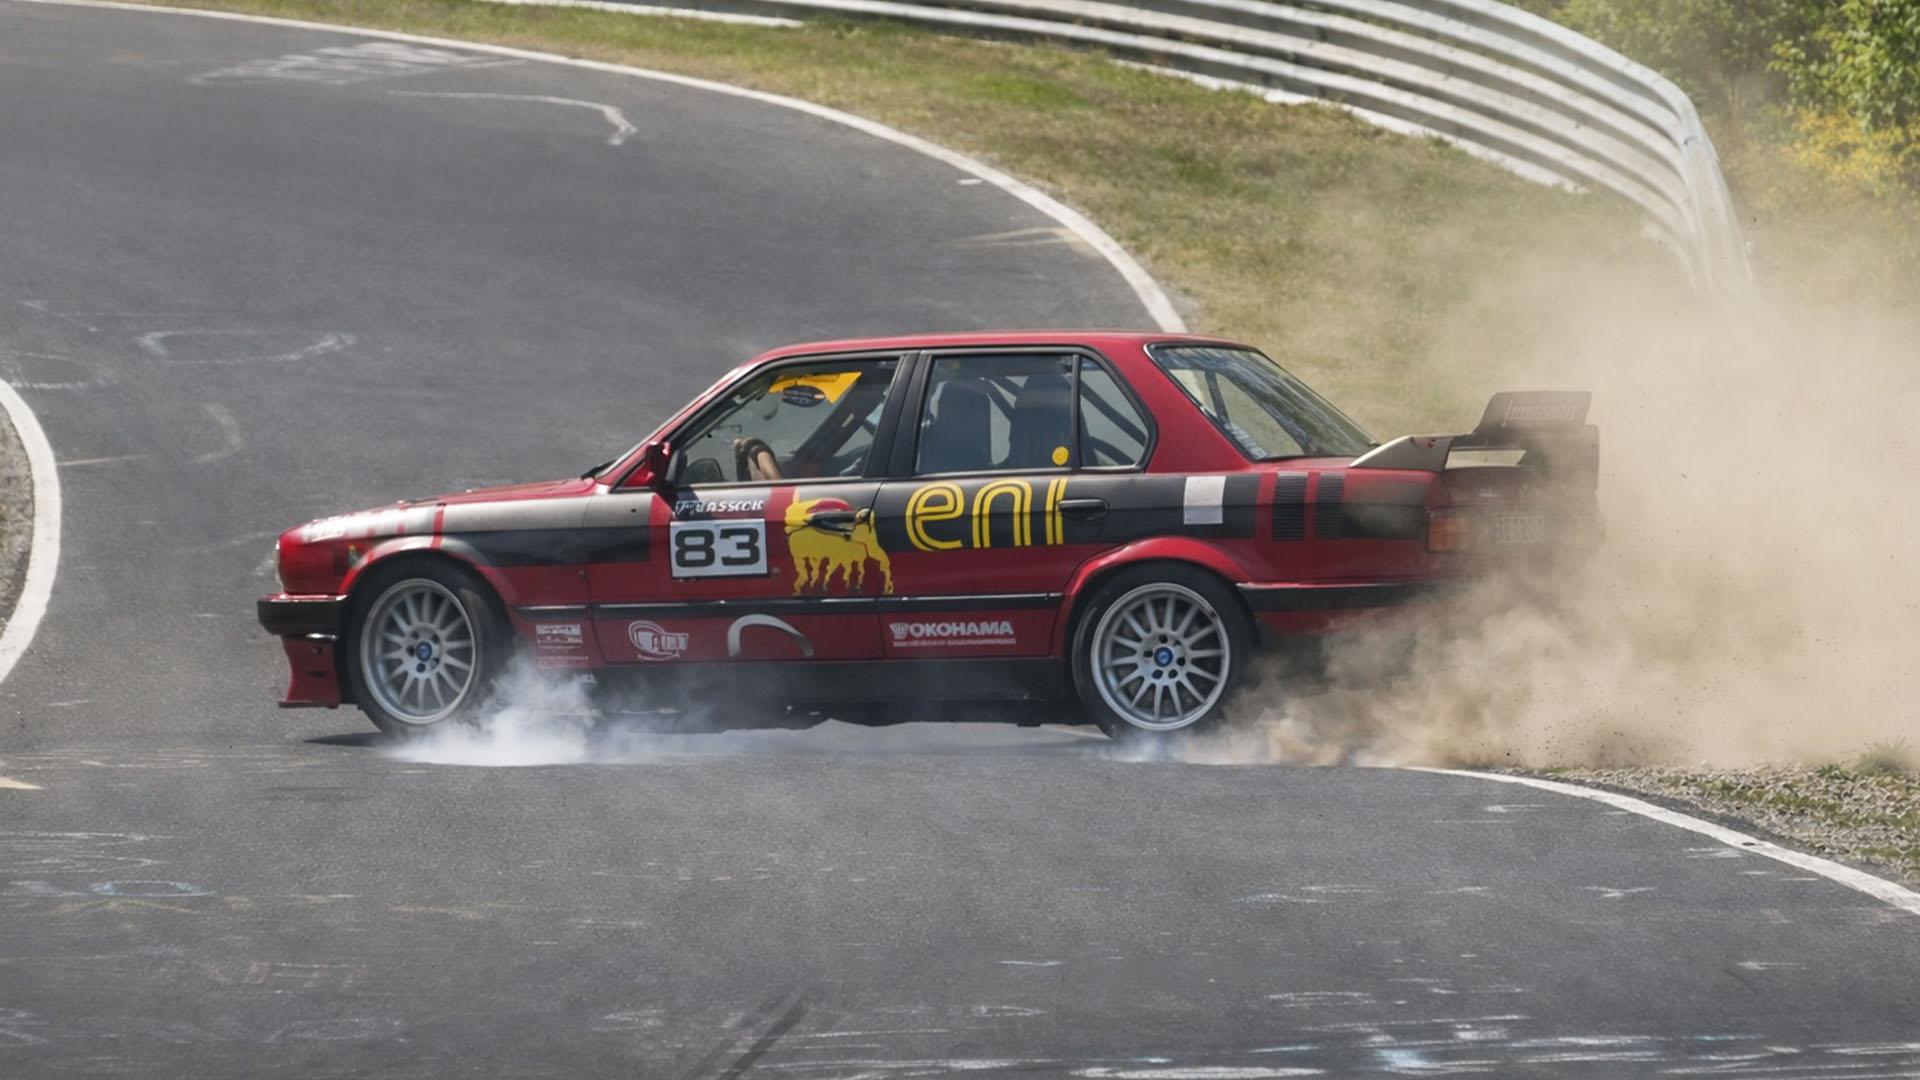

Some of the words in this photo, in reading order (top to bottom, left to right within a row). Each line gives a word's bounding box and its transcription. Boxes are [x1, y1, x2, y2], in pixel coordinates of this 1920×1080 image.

[905, 446, 1069, 551] eni
[675, 527, 760, 568] 83
[890, 621, 1015, 640] YOKOHAMA
